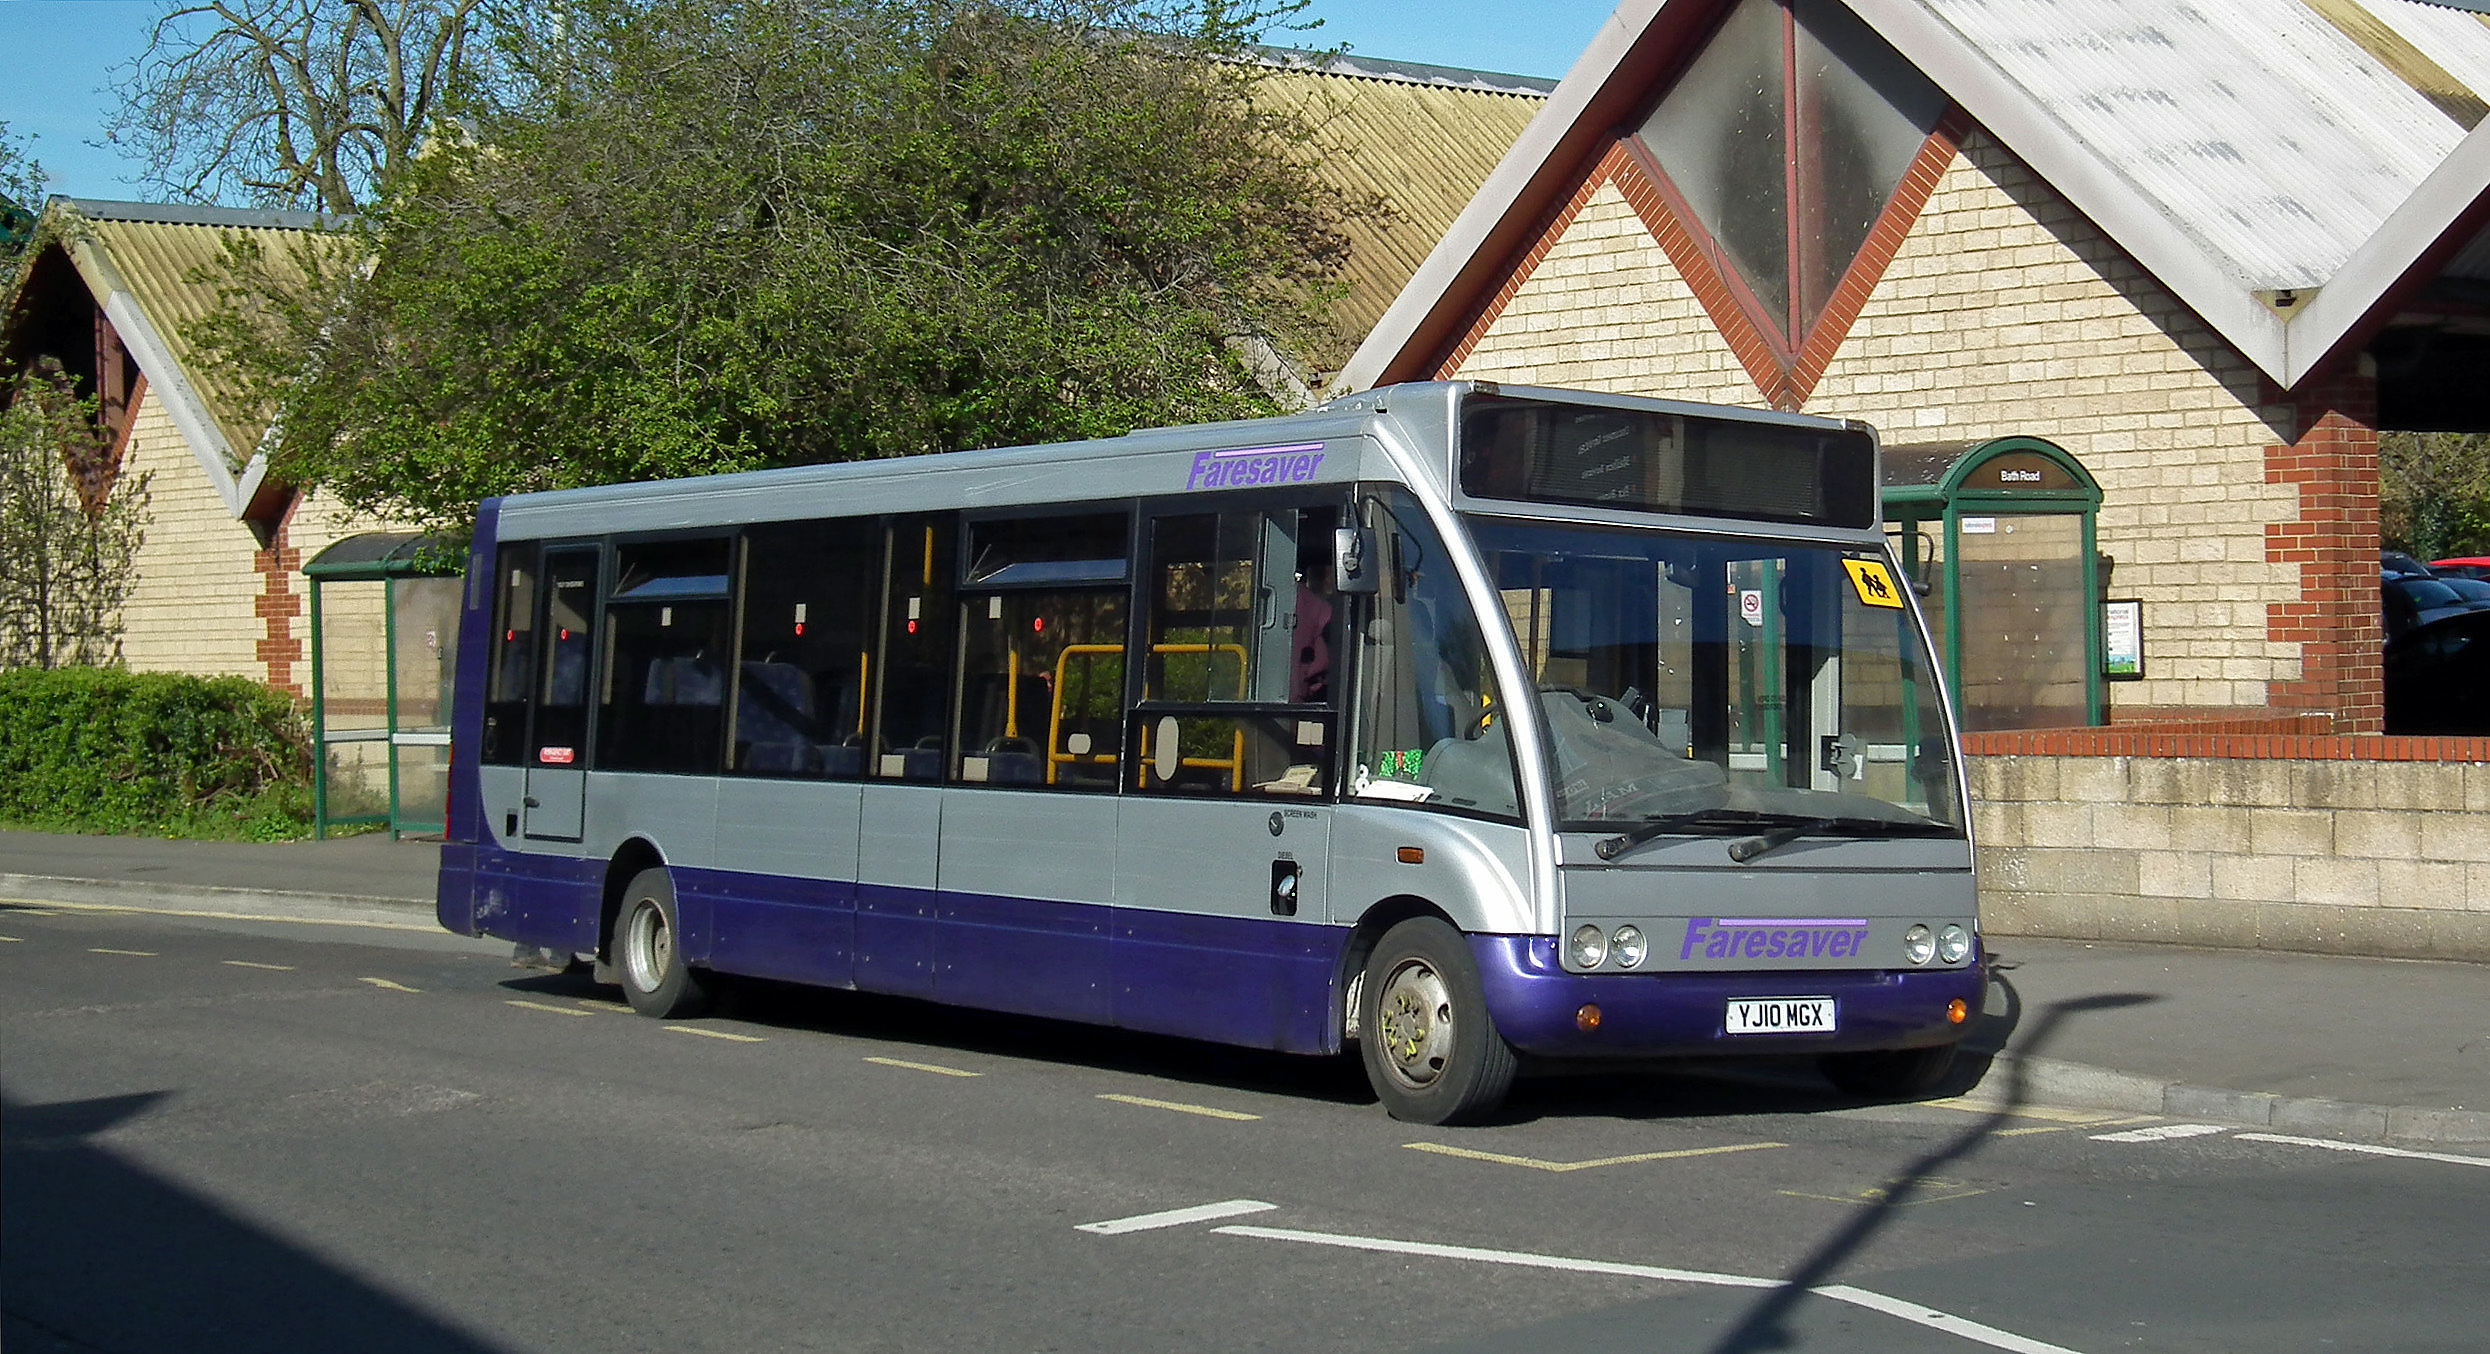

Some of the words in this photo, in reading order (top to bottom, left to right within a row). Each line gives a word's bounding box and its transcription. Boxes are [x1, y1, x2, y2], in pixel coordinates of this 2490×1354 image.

[1186, 451, 1325, 491] Faresaver
[2000, 470, 2019, 481] Bath
[2020, 470, 2040, 481] Road
[1284, 809, 1302, 818] SCREEN
[1303, 811, 1318, 820] WASH
[1680, 918, 1869, 960] Faresaver
[1739, 1004, 1781, 1028] YJ10
[1787, 1003, 1823, 1027] MGX
